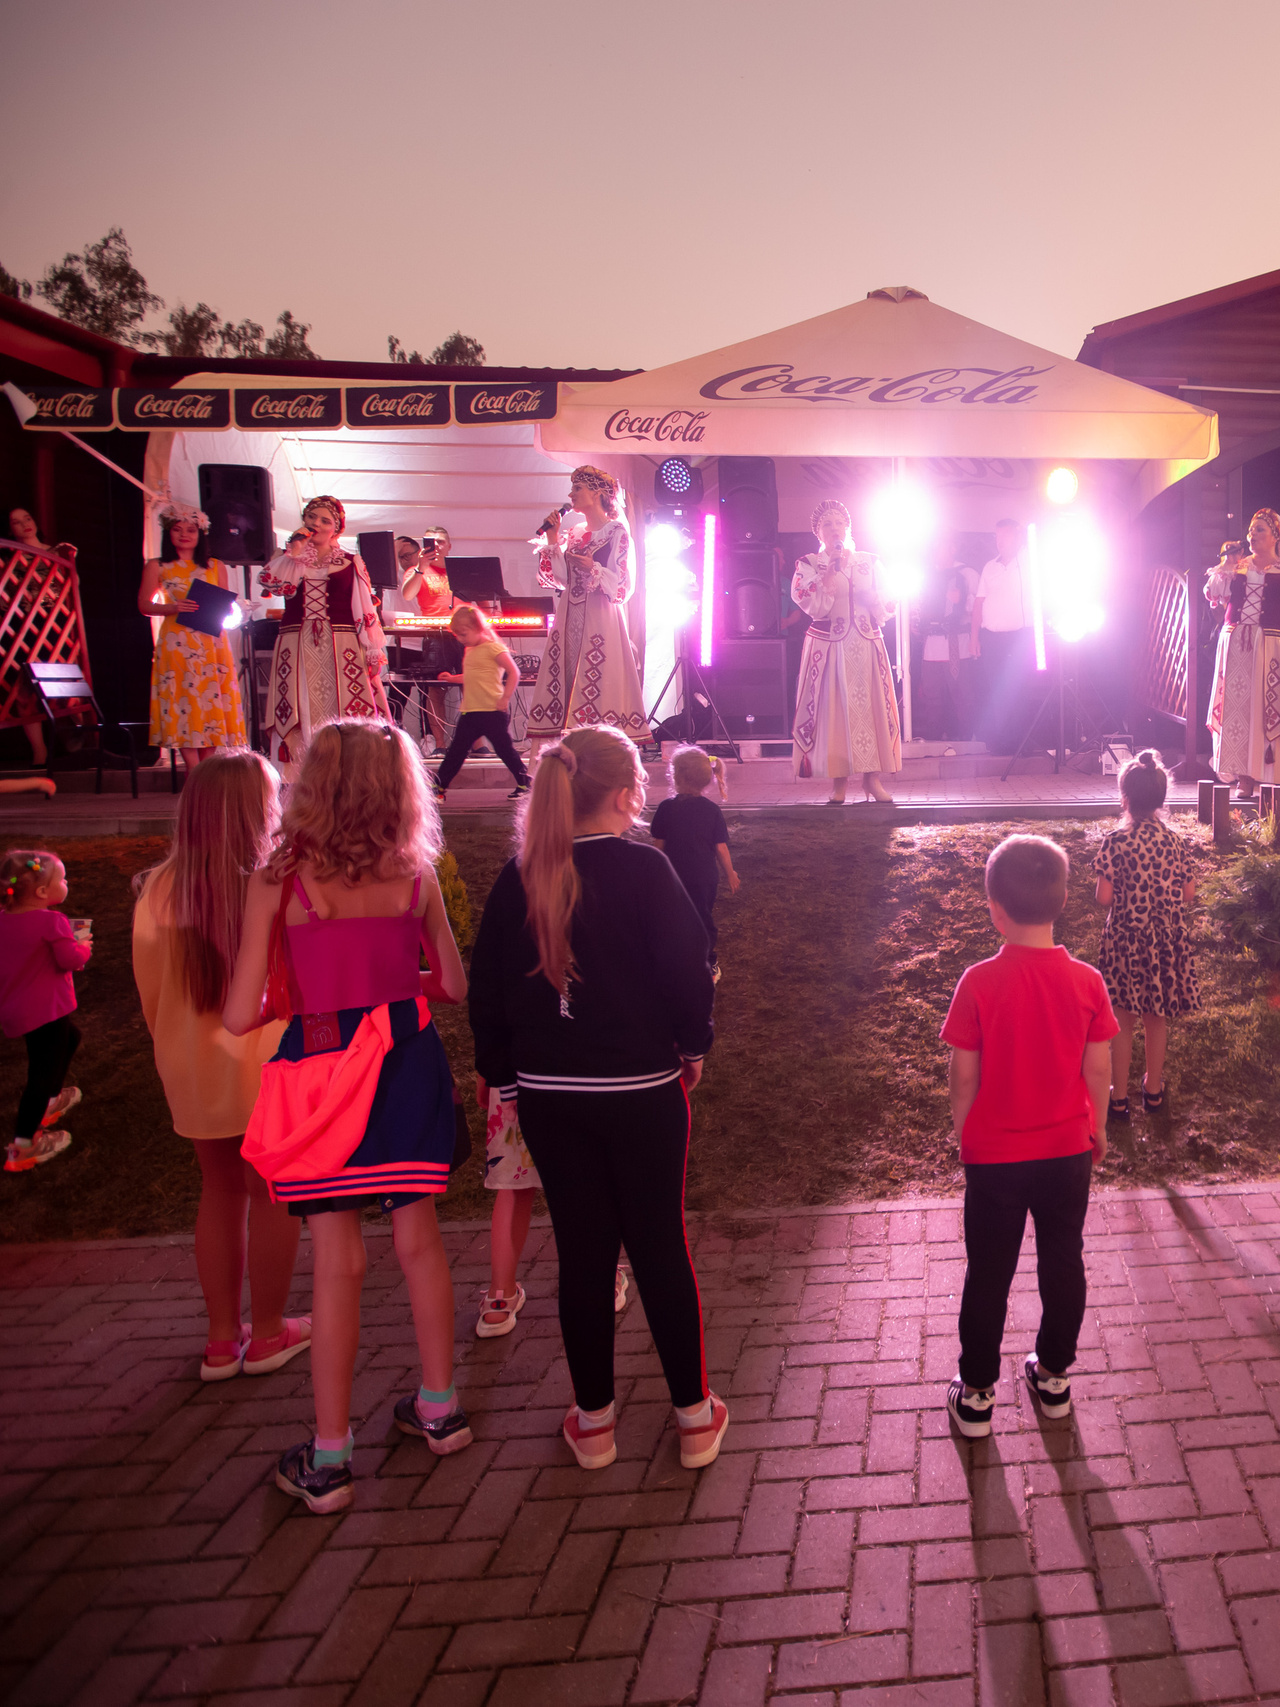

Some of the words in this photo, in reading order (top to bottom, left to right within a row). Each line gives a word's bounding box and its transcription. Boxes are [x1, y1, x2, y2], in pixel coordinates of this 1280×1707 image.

[699, 364, 1057, 404] Coca-Cola
[25, 392, 99, 418] ca-Cola
[134, 394, 217, 419] Coca-Cola
[251, 394, 328, 419] Coca-Cola
[361, 392, 438, 418] Coca-Cola
[470, 389, 545, 415] Coca-Cola
[604, 408, 712, 443] Coca-Cola
